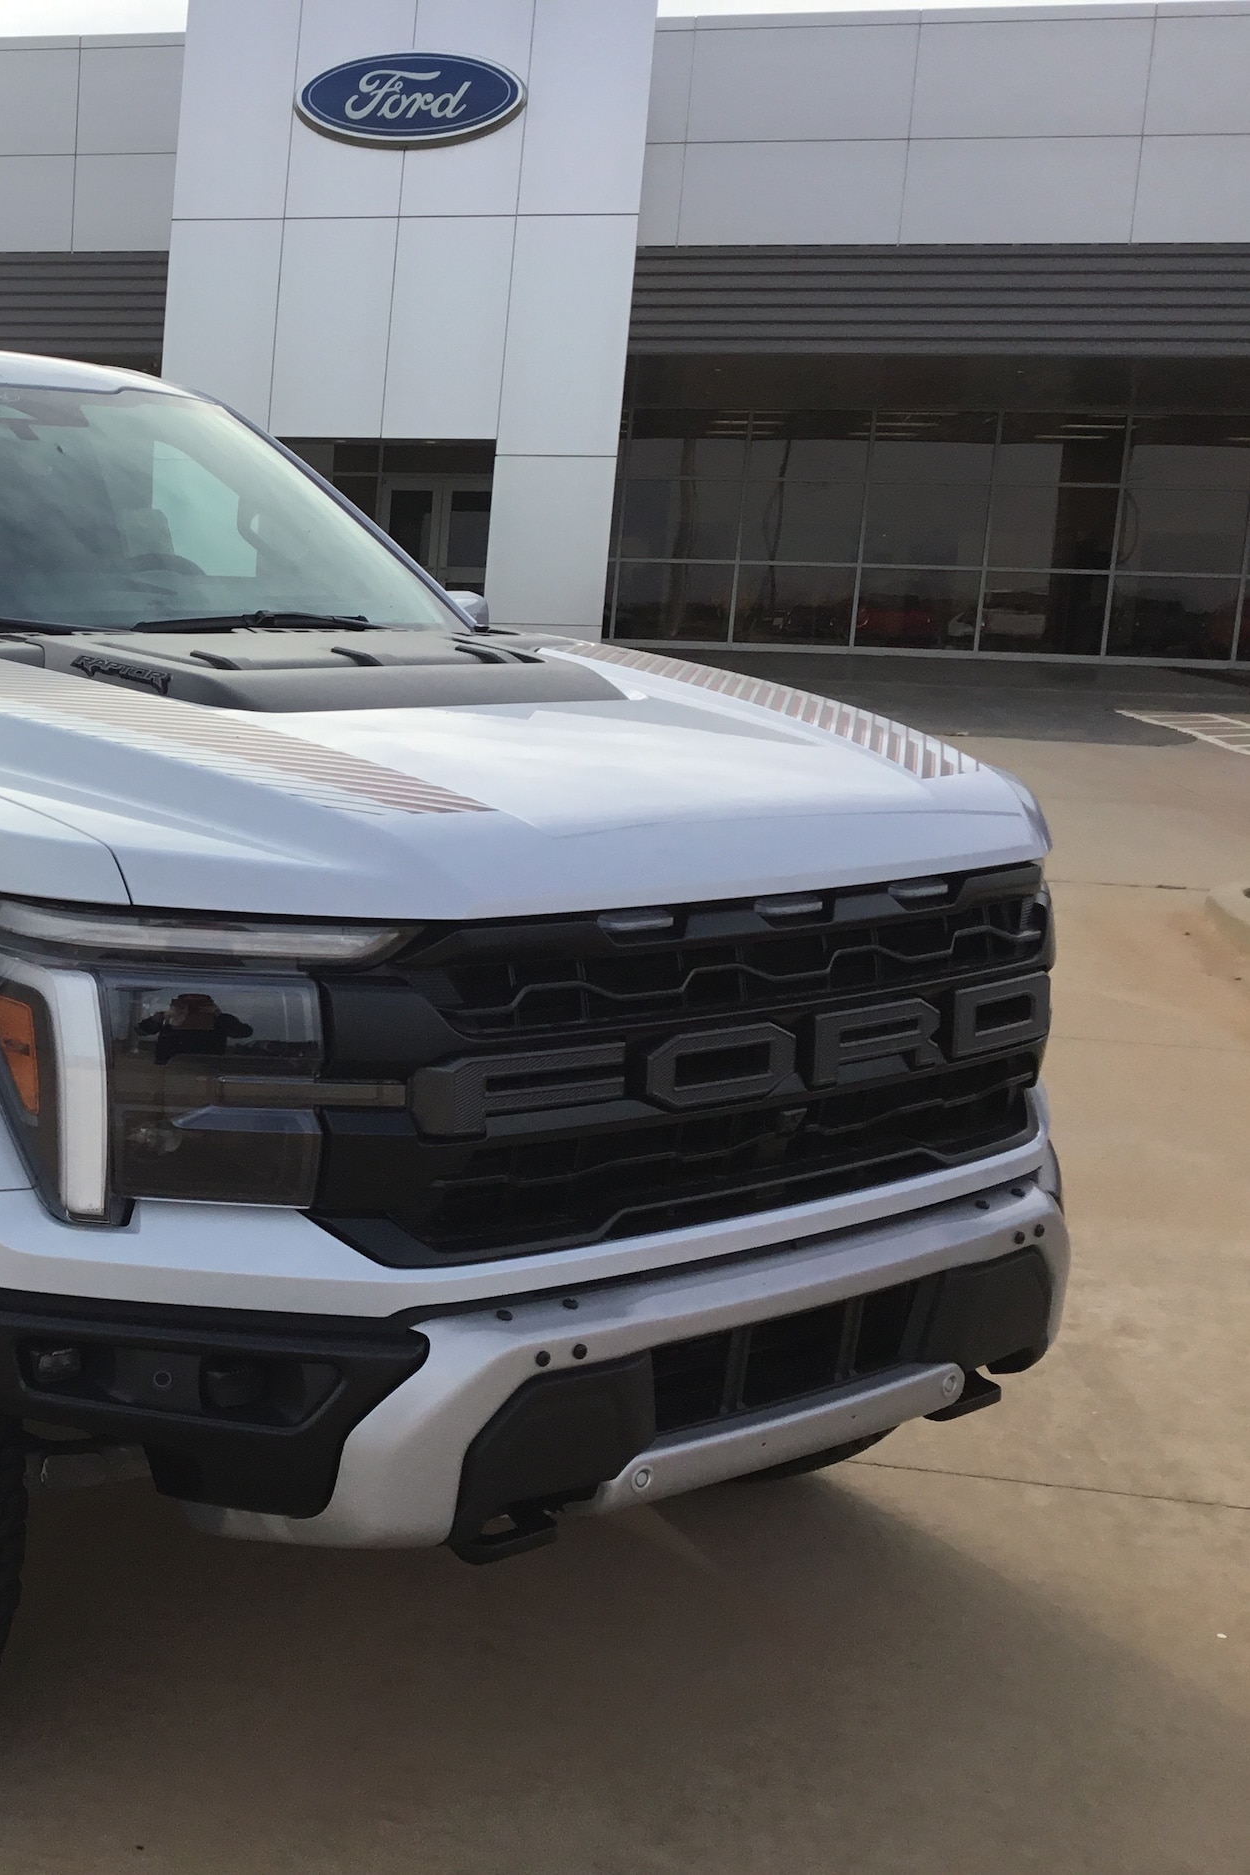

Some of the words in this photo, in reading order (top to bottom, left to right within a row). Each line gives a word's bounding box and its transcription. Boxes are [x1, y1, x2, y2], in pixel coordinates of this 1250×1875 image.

[344, 69, 473, 120] Ford
[70, 655, 172, 695] RAPTOR
[412, 972, 1050, 1140] FORD
